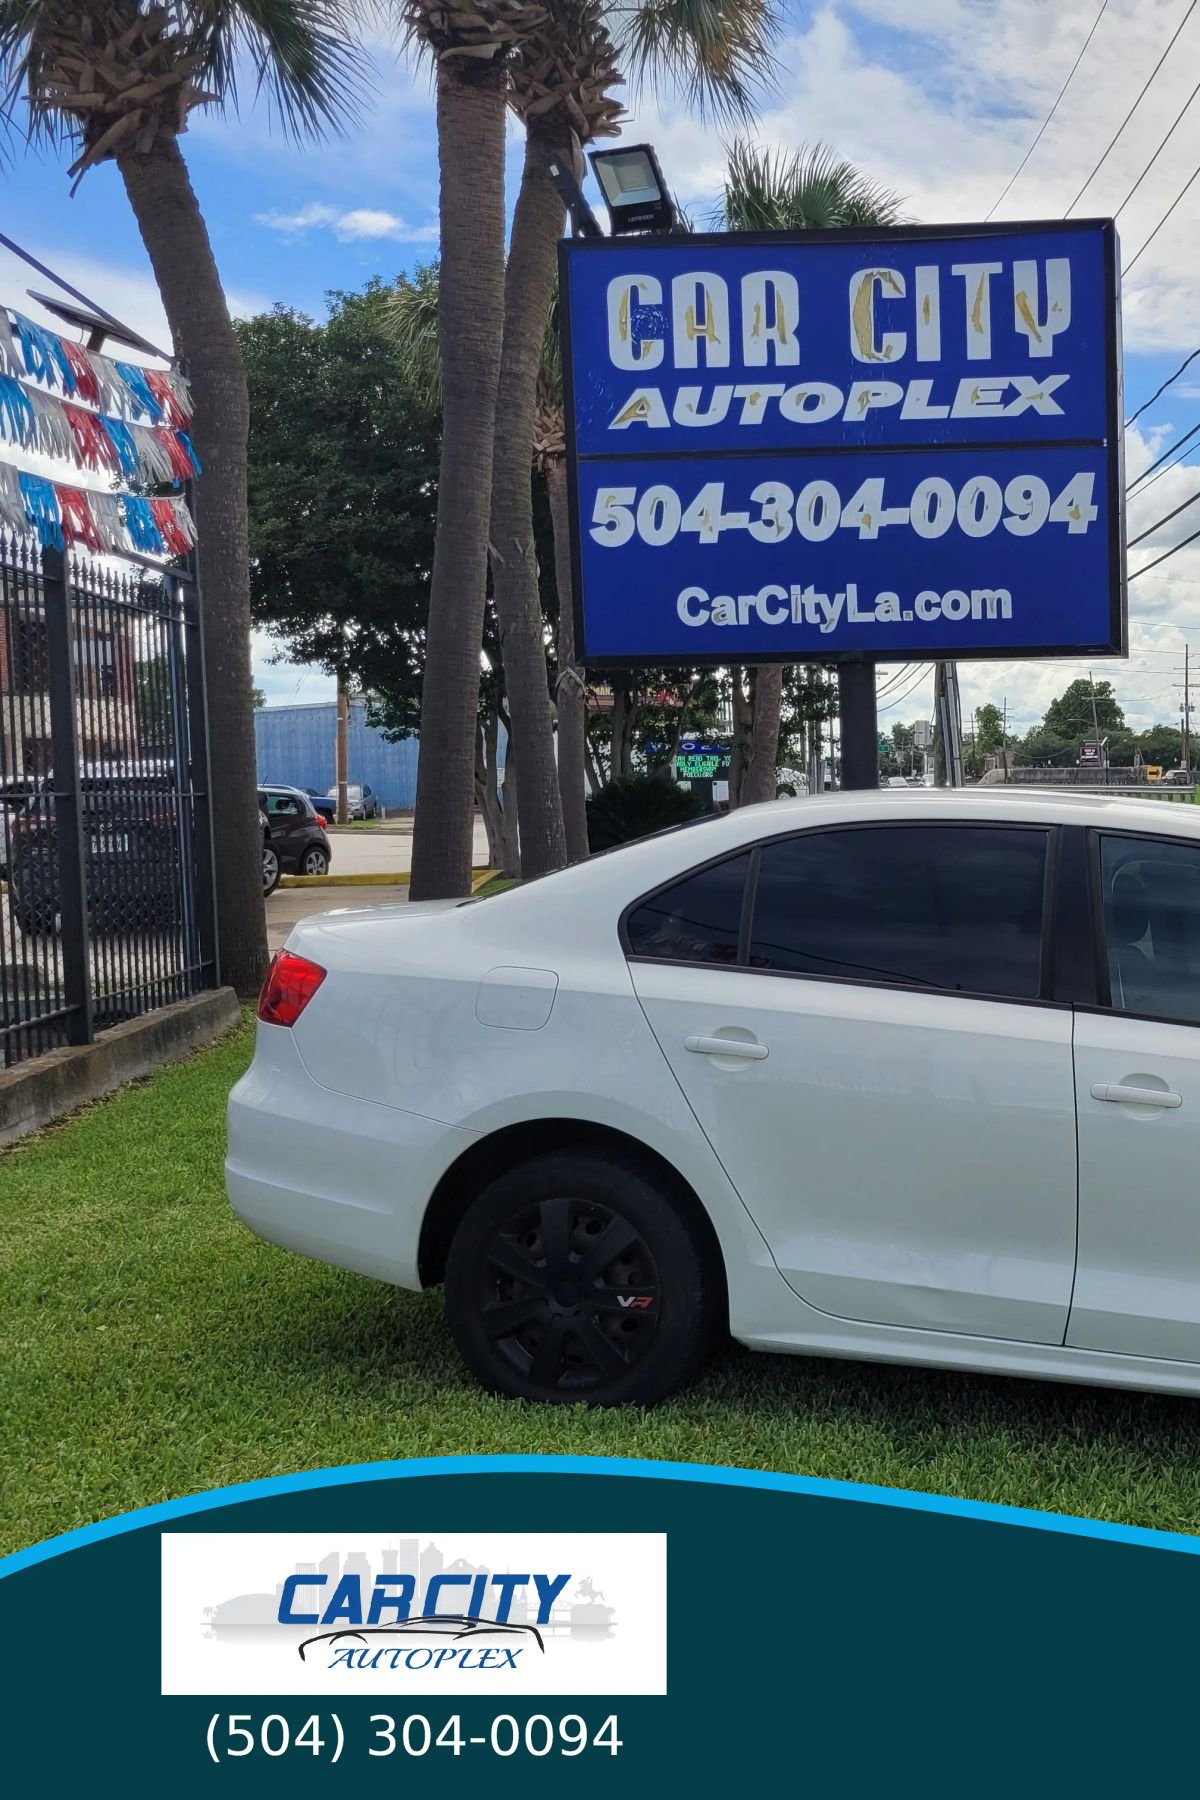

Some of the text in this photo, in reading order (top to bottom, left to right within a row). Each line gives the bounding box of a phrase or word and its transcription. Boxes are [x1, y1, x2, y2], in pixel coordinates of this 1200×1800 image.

[606, 258, 1072, 371] CAR CITY
[607, 374, 1071, 430] AUTOPLEX
[588, 471, 1099, 548] 504-304-0094
[676, 582, 1013, 634] CarCityLa.com
